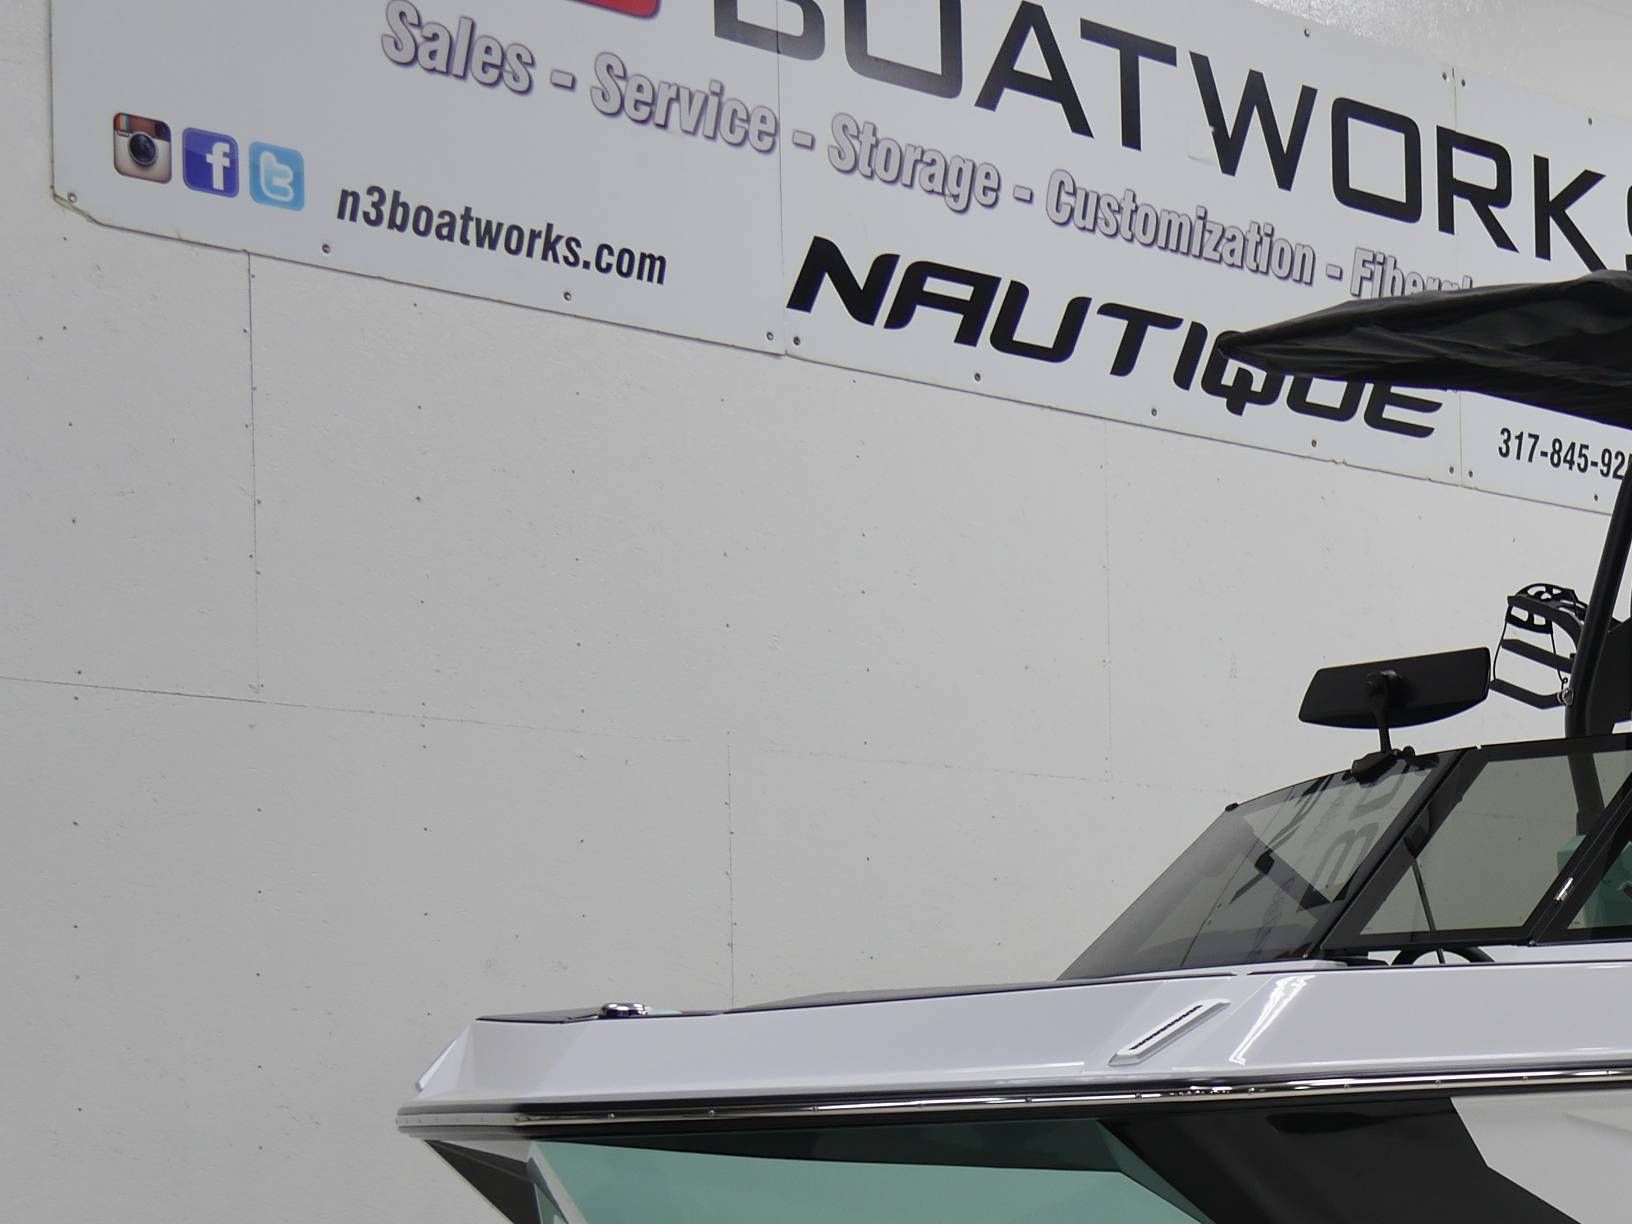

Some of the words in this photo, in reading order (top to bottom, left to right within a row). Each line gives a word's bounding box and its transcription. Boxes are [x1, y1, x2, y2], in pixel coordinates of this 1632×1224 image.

[336, 185, 668, 285] n3boatworks.com
[381, 0, 535, 95] Sales
[590, 51, 781, 153] Service
[827, 112, 1001, 214] Storage
[1045, 168, 1316, 285] Customization
[786, 236, 1443, 438] NAUTIQUE
